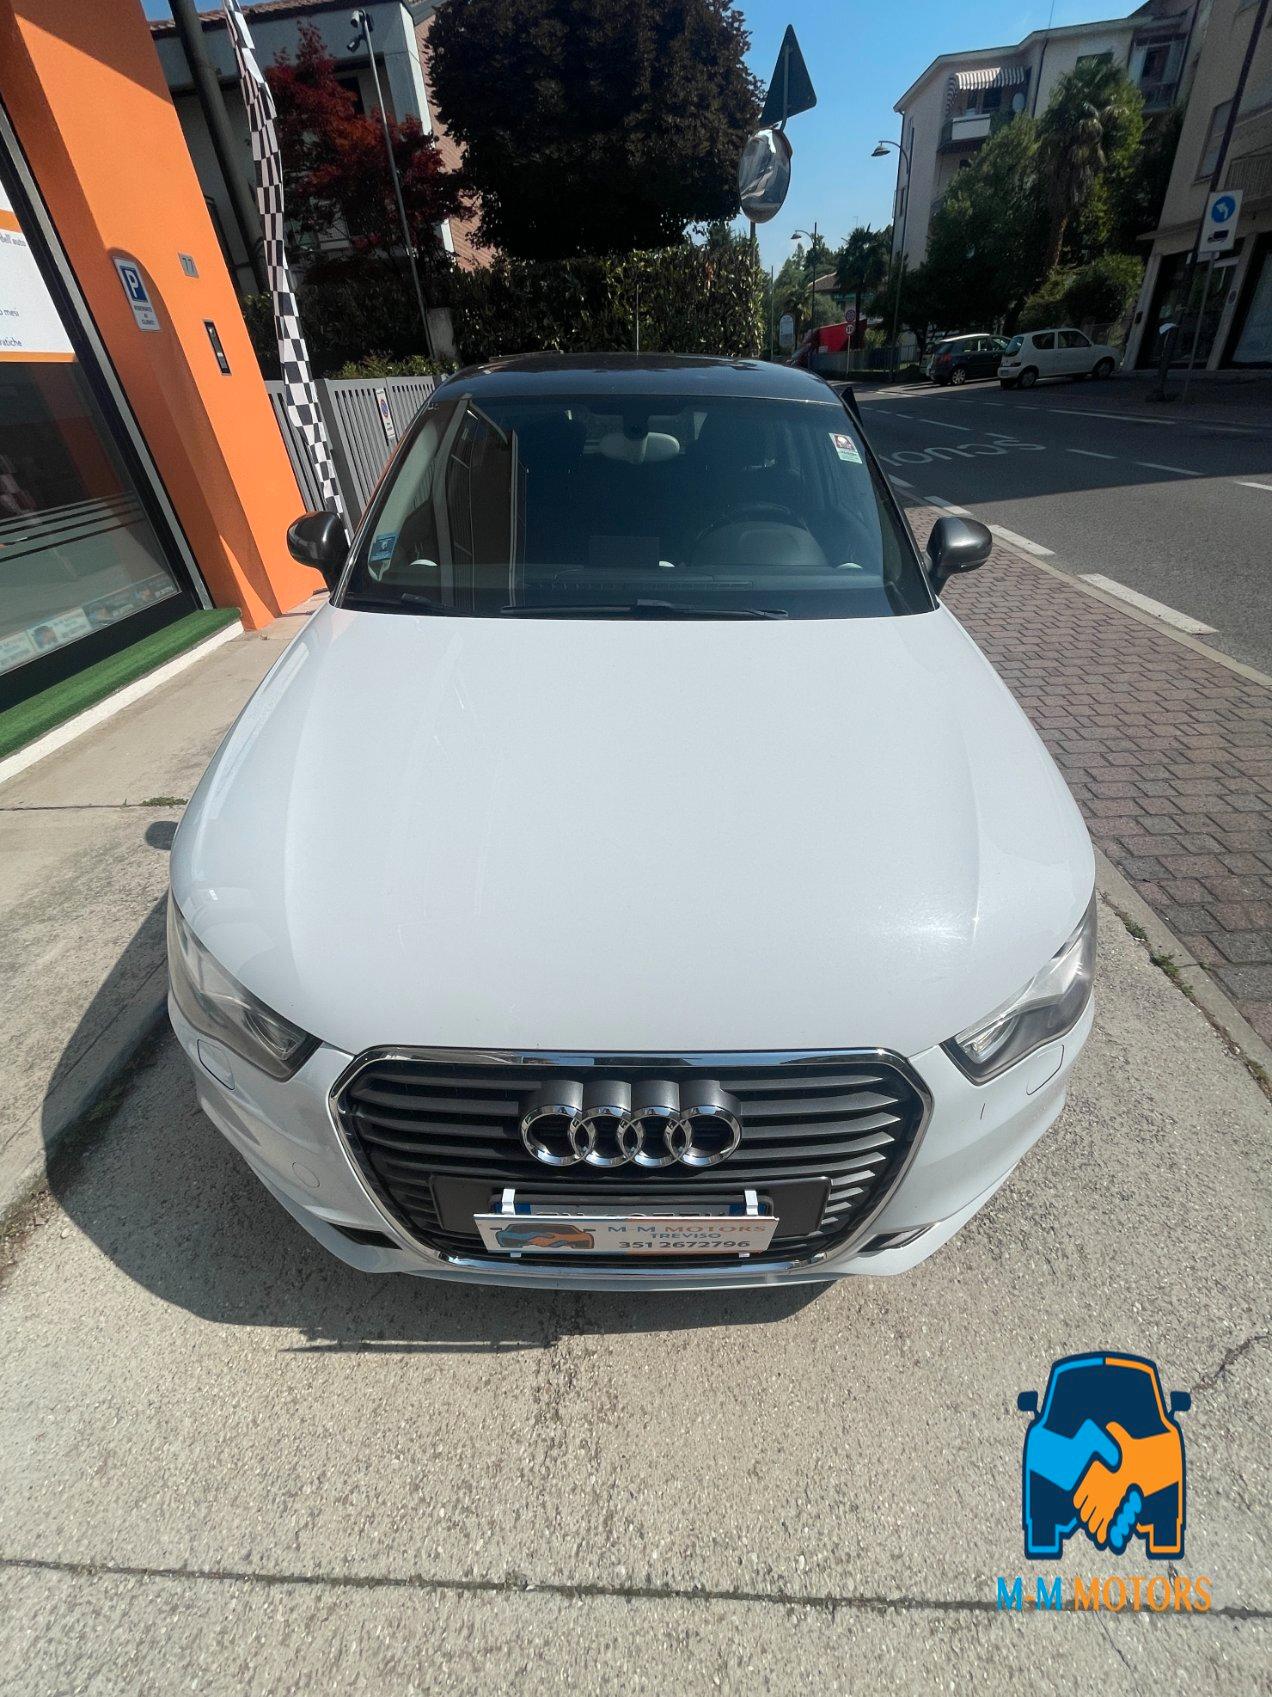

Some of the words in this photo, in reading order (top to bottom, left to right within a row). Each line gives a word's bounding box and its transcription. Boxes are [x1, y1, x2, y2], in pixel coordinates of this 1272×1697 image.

[124, 269, 138, 298] P
[664, 1225, 767, 1233] MOTORS
[618, 1241, 653, 1249] 351
[659, 1240, 751, 1249] 2672796
